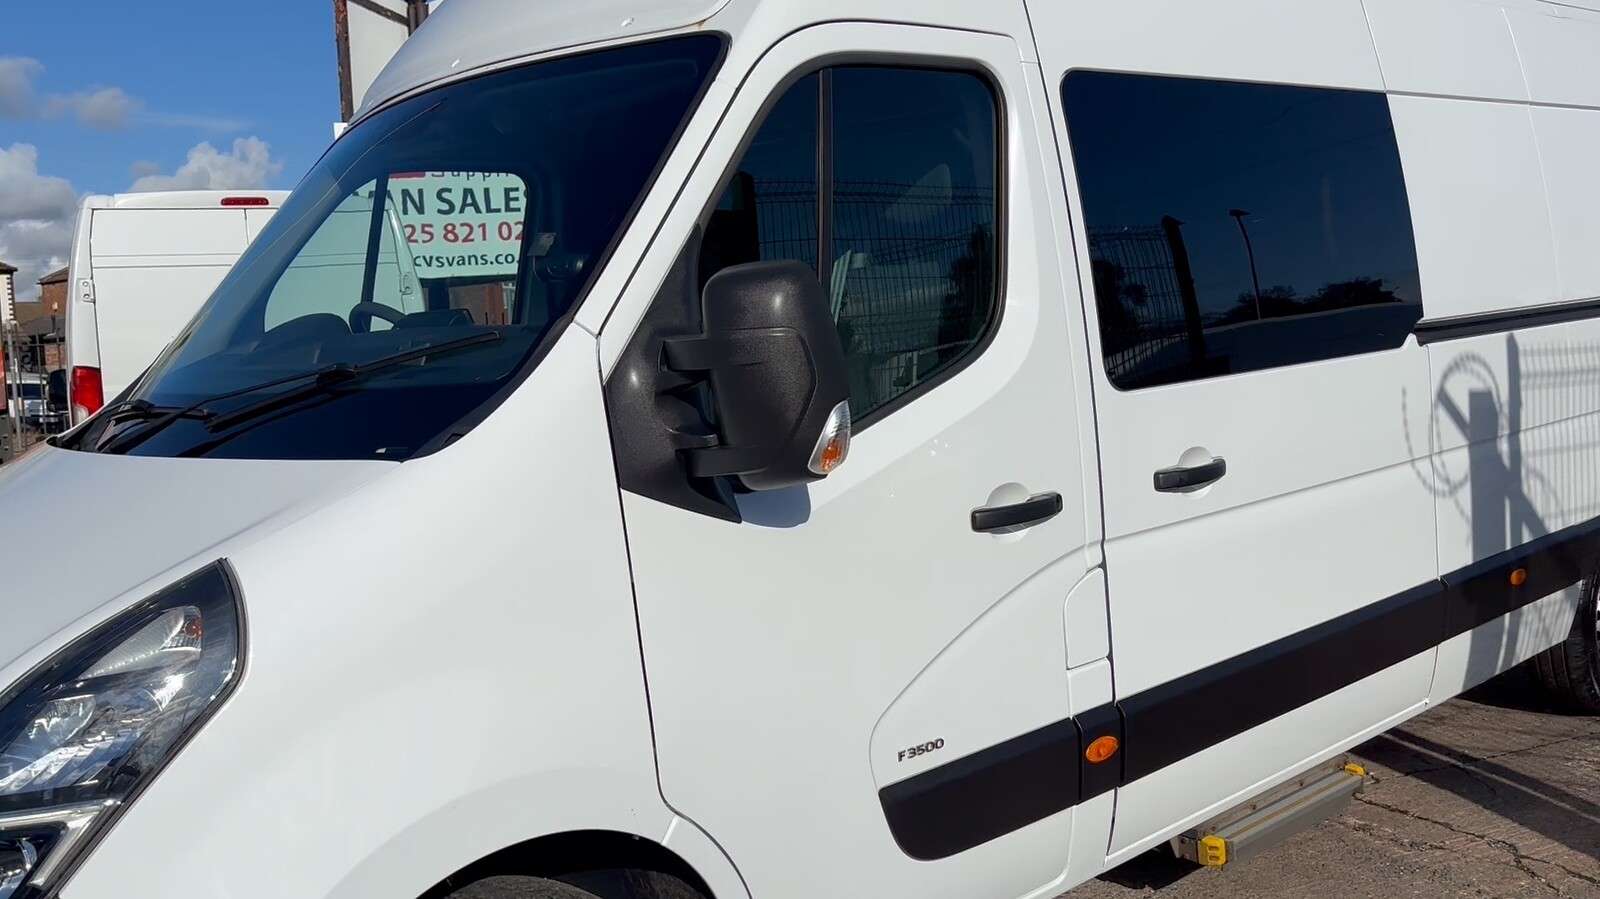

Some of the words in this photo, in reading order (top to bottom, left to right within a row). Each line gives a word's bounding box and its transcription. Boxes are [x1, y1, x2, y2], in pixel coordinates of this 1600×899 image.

[436, 187, 528, 215] SALE
[443, 222, 487, 243] 821
[897, 738, 945, 762] F3500
